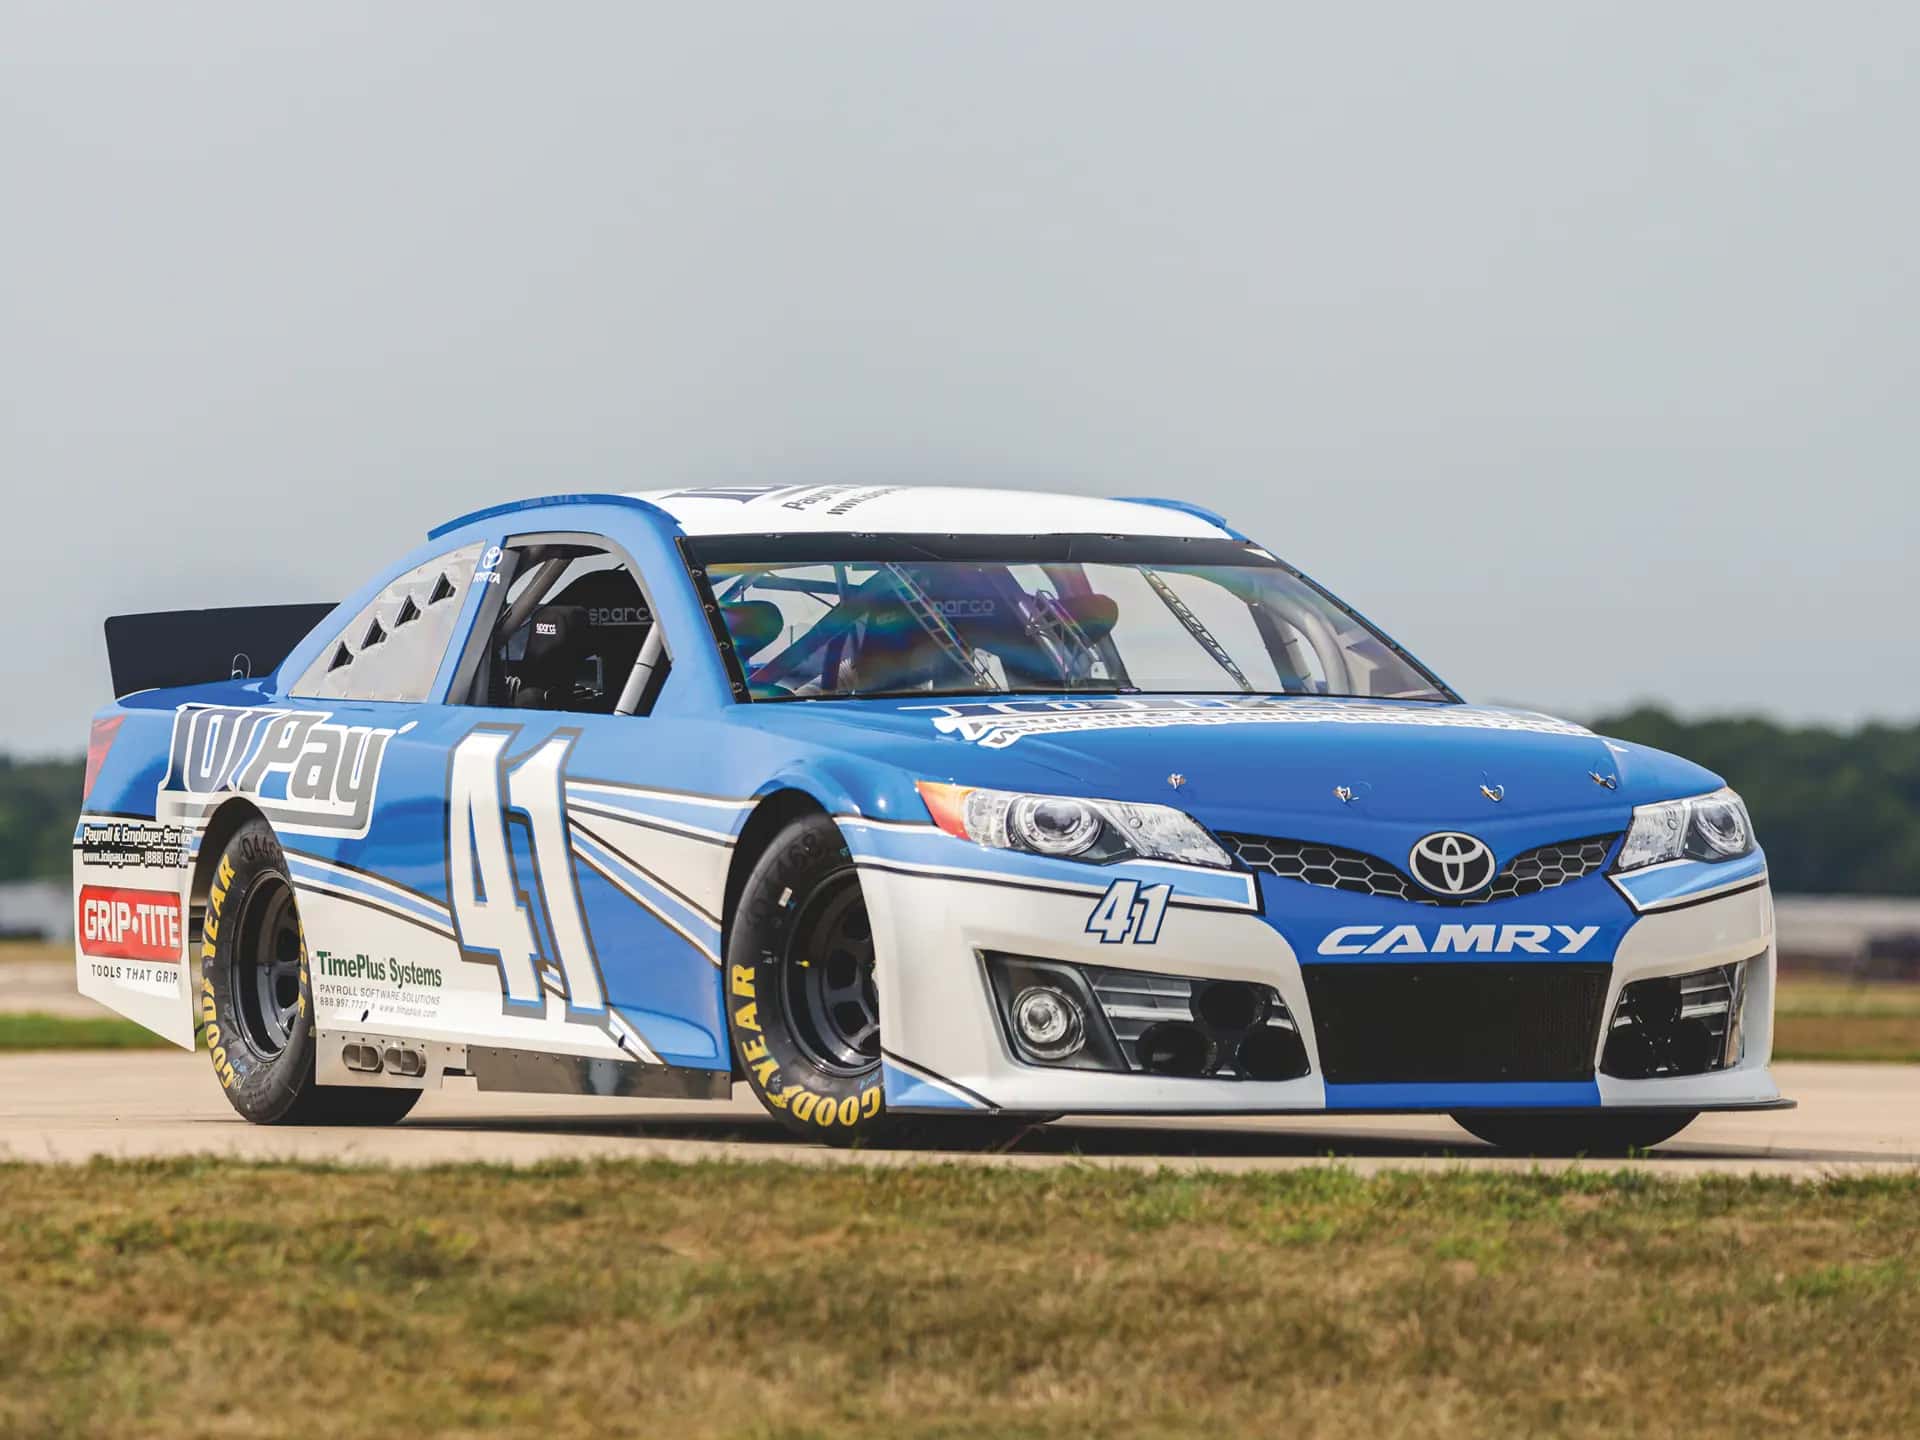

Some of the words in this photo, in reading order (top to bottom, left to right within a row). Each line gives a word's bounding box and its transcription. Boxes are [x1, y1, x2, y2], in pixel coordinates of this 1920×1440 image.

[83, 826, 113, 845] Payroll
[114, 826, 121, 841] &
[122, 826, 163, 846] Employer
[447, 723, 610, 1025] 41
[1085, 878, 1175, 944] 41
[1317, 924, 1600, 954] CAMRY
[91, 964, 121, 978] TOOLS
[126, 967, 152, 982] THAT
[156, 970, 178, 984] GRIP
[316, 950, 387, 981] TimePlus
[389, 957, 442, 989] Systems
[319, 983, 358, 997] PAYROLL
[360, 987, 401, 1001] SOFTWARE
[402, 992, 441, 1006] SOLUTIONS
[732, 964, 880, 1127] GOODYEAR
